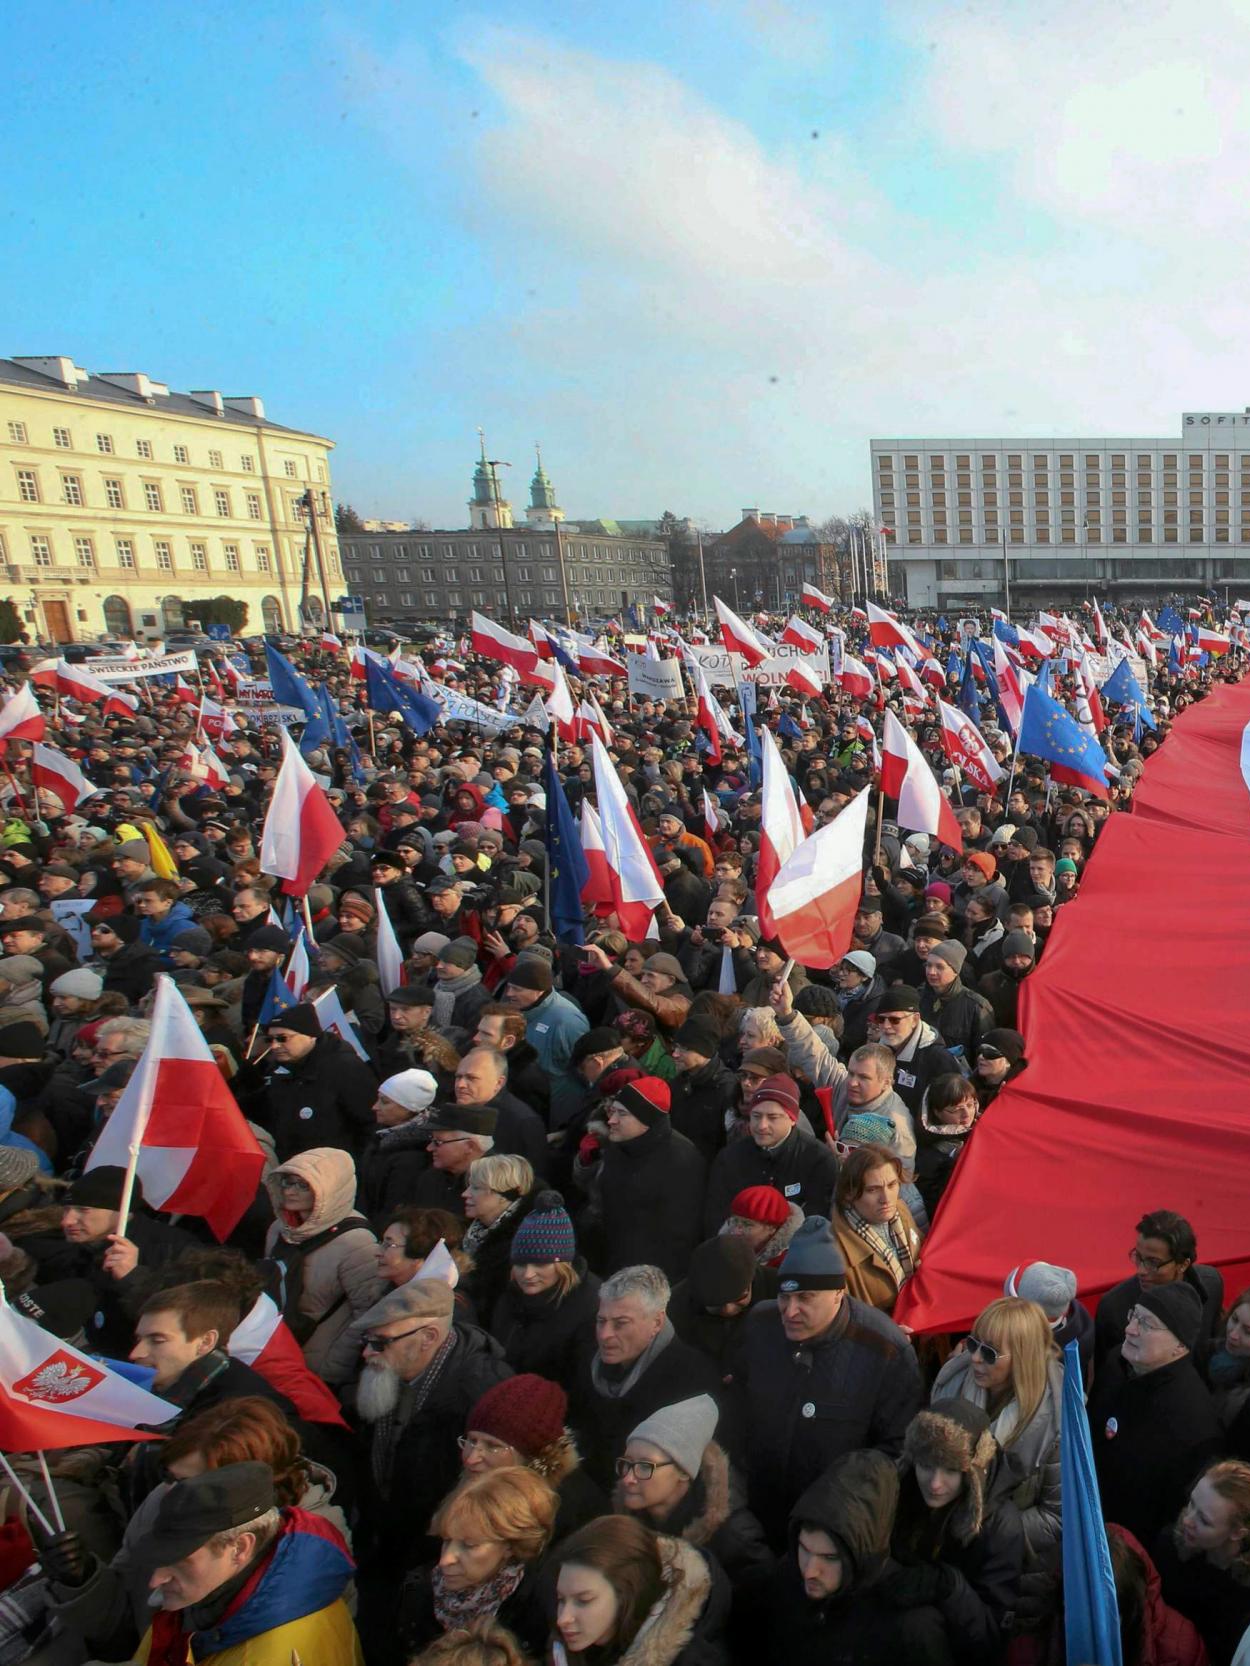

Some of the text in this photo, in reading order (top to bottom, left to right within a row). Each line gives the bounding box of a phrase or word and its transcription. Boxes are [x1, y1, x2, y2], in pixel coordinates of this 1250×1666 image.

[88, 655, 189, 675] ŚWIECKIE PAŃSTWO
[741, 662, 763, 671] DA
[742, 671, 828, 686] WOLNCI
